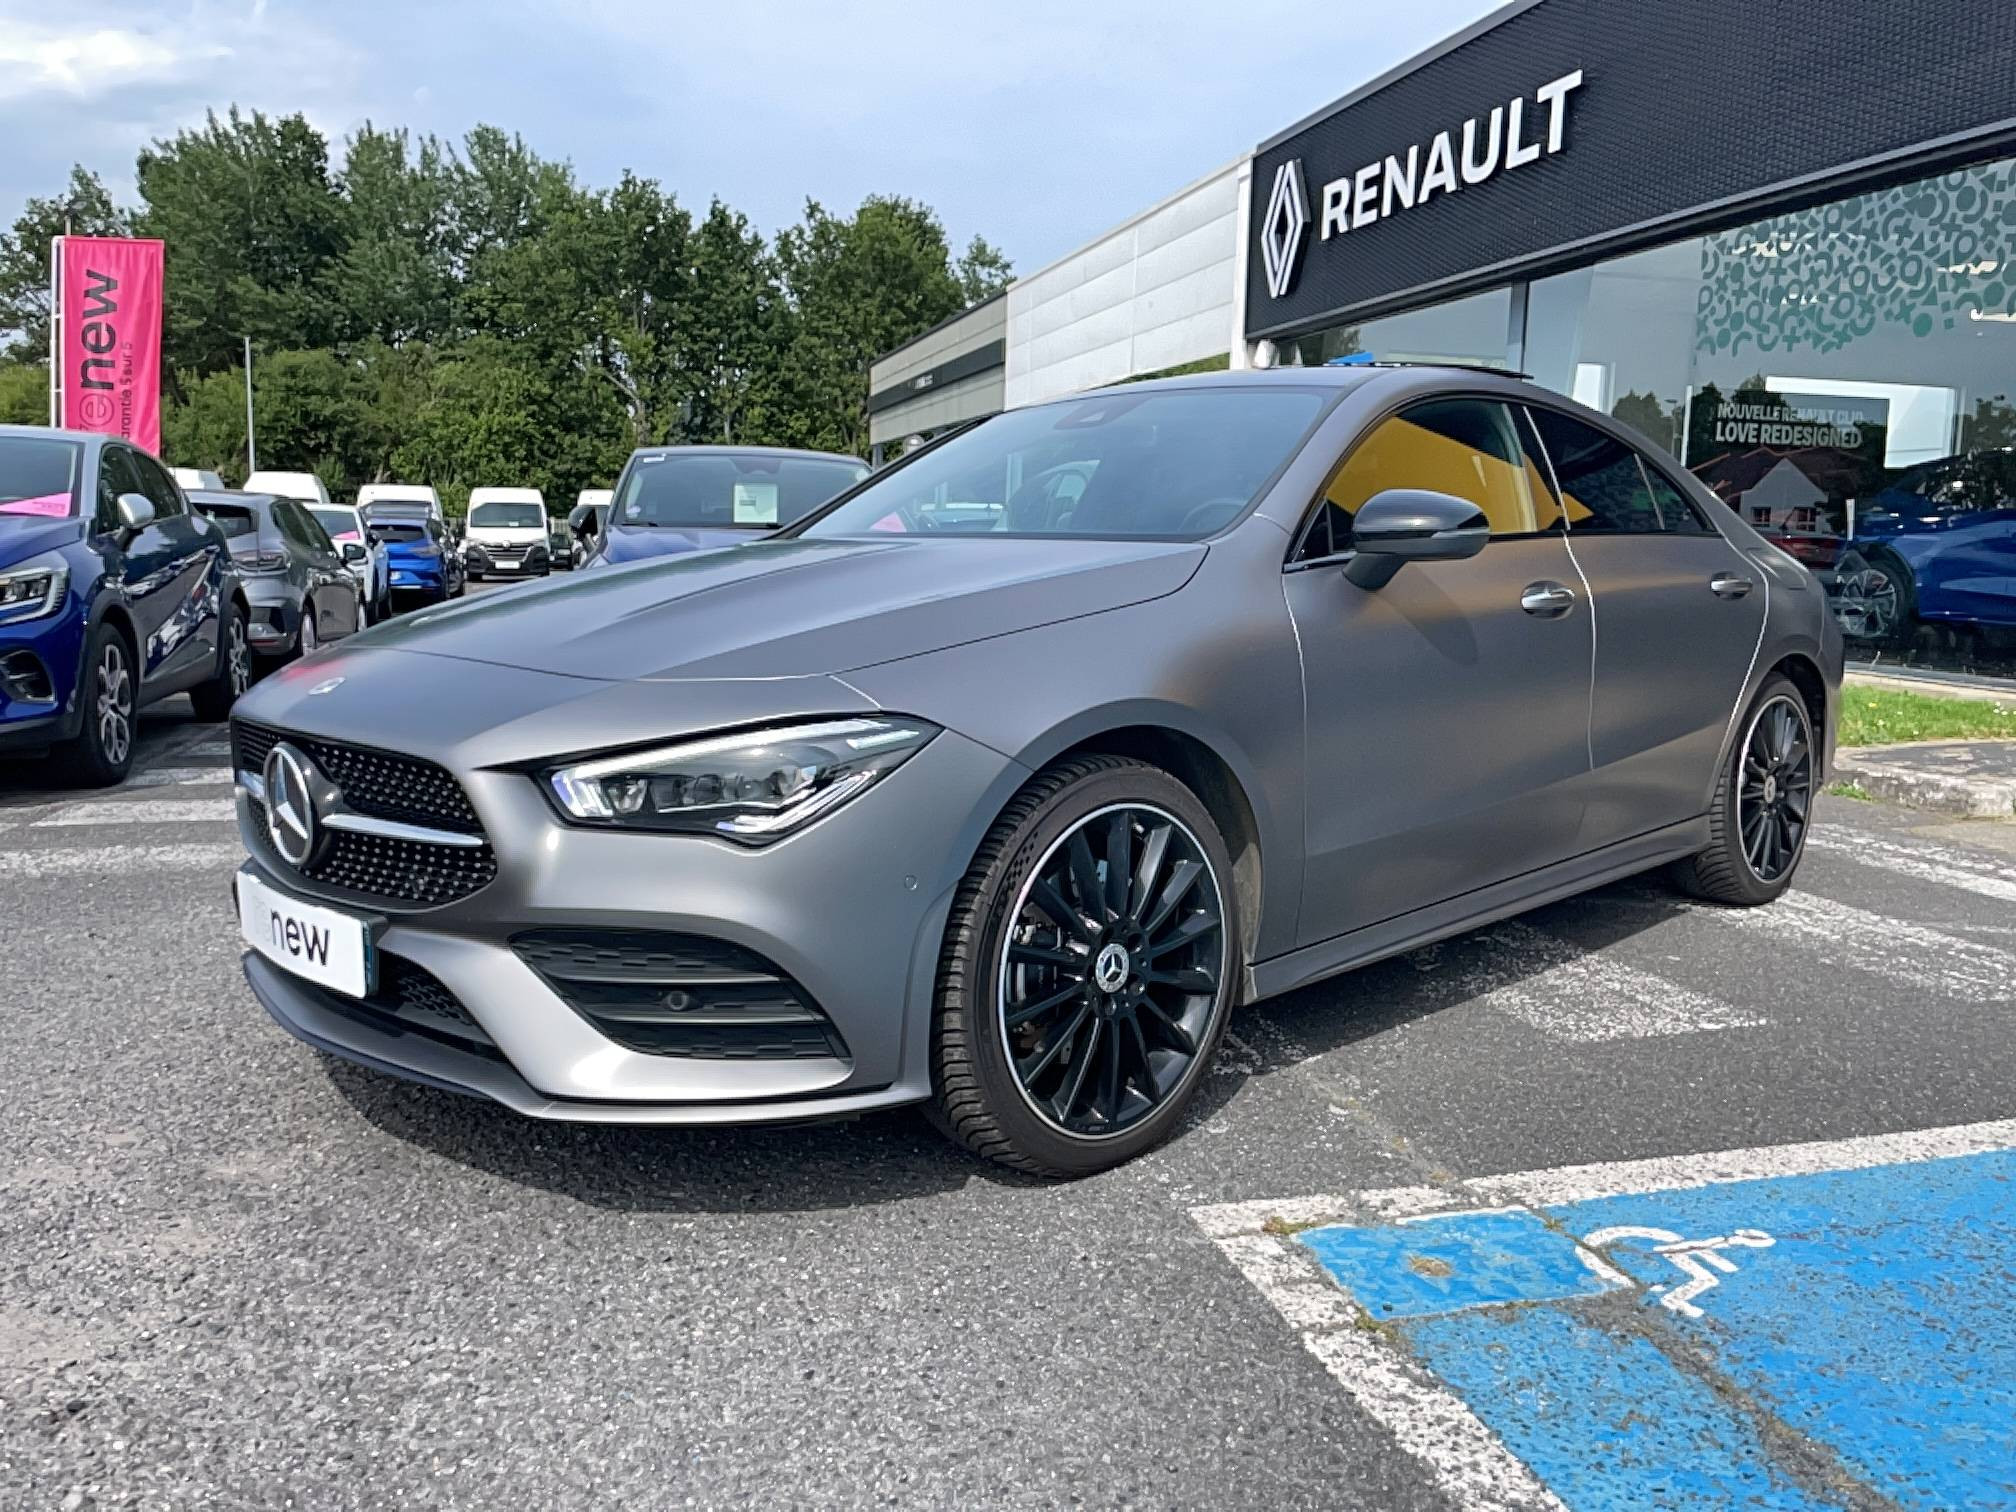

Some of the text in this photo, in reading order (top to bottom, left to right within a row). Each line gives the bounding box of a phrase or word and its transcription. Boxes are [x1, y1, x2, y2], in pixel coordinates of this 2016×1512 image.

[1320, 69, 1583, 242] RENAULT
[79, 268, 118, 431] enew
[121, 389, 133, 439] arantie
[1716, 421, 1863, 448] LOVE REDESIGNED
[1718, 403, 1780, 420] NOUVELLE
